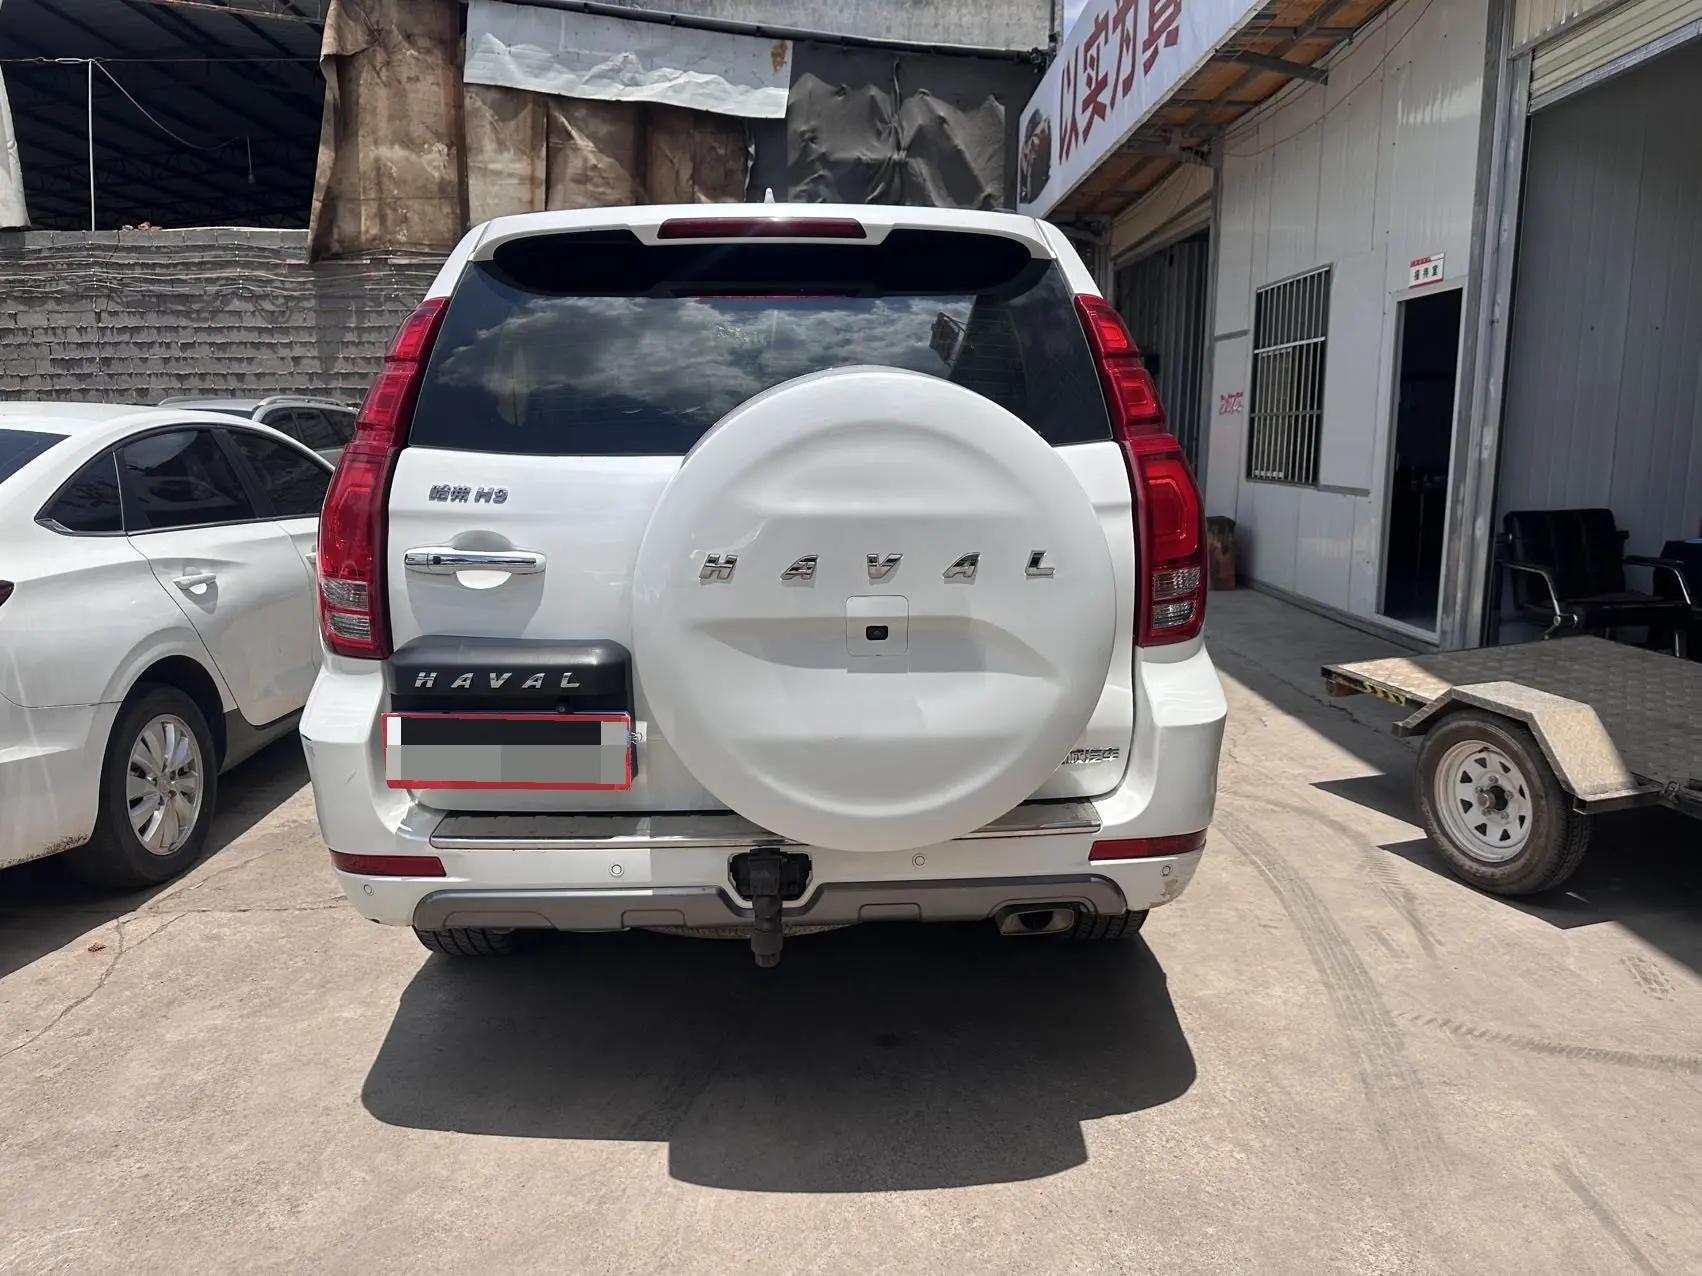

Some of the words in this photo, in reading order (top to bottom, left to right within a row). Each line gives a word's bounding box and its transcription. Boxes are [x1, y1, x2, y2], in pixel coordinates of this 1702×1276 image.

[474, 487, 508, 504] H9
[699, 550, 1055, 581] HAVAL
[414, 671, 580, 689] HAVAL
